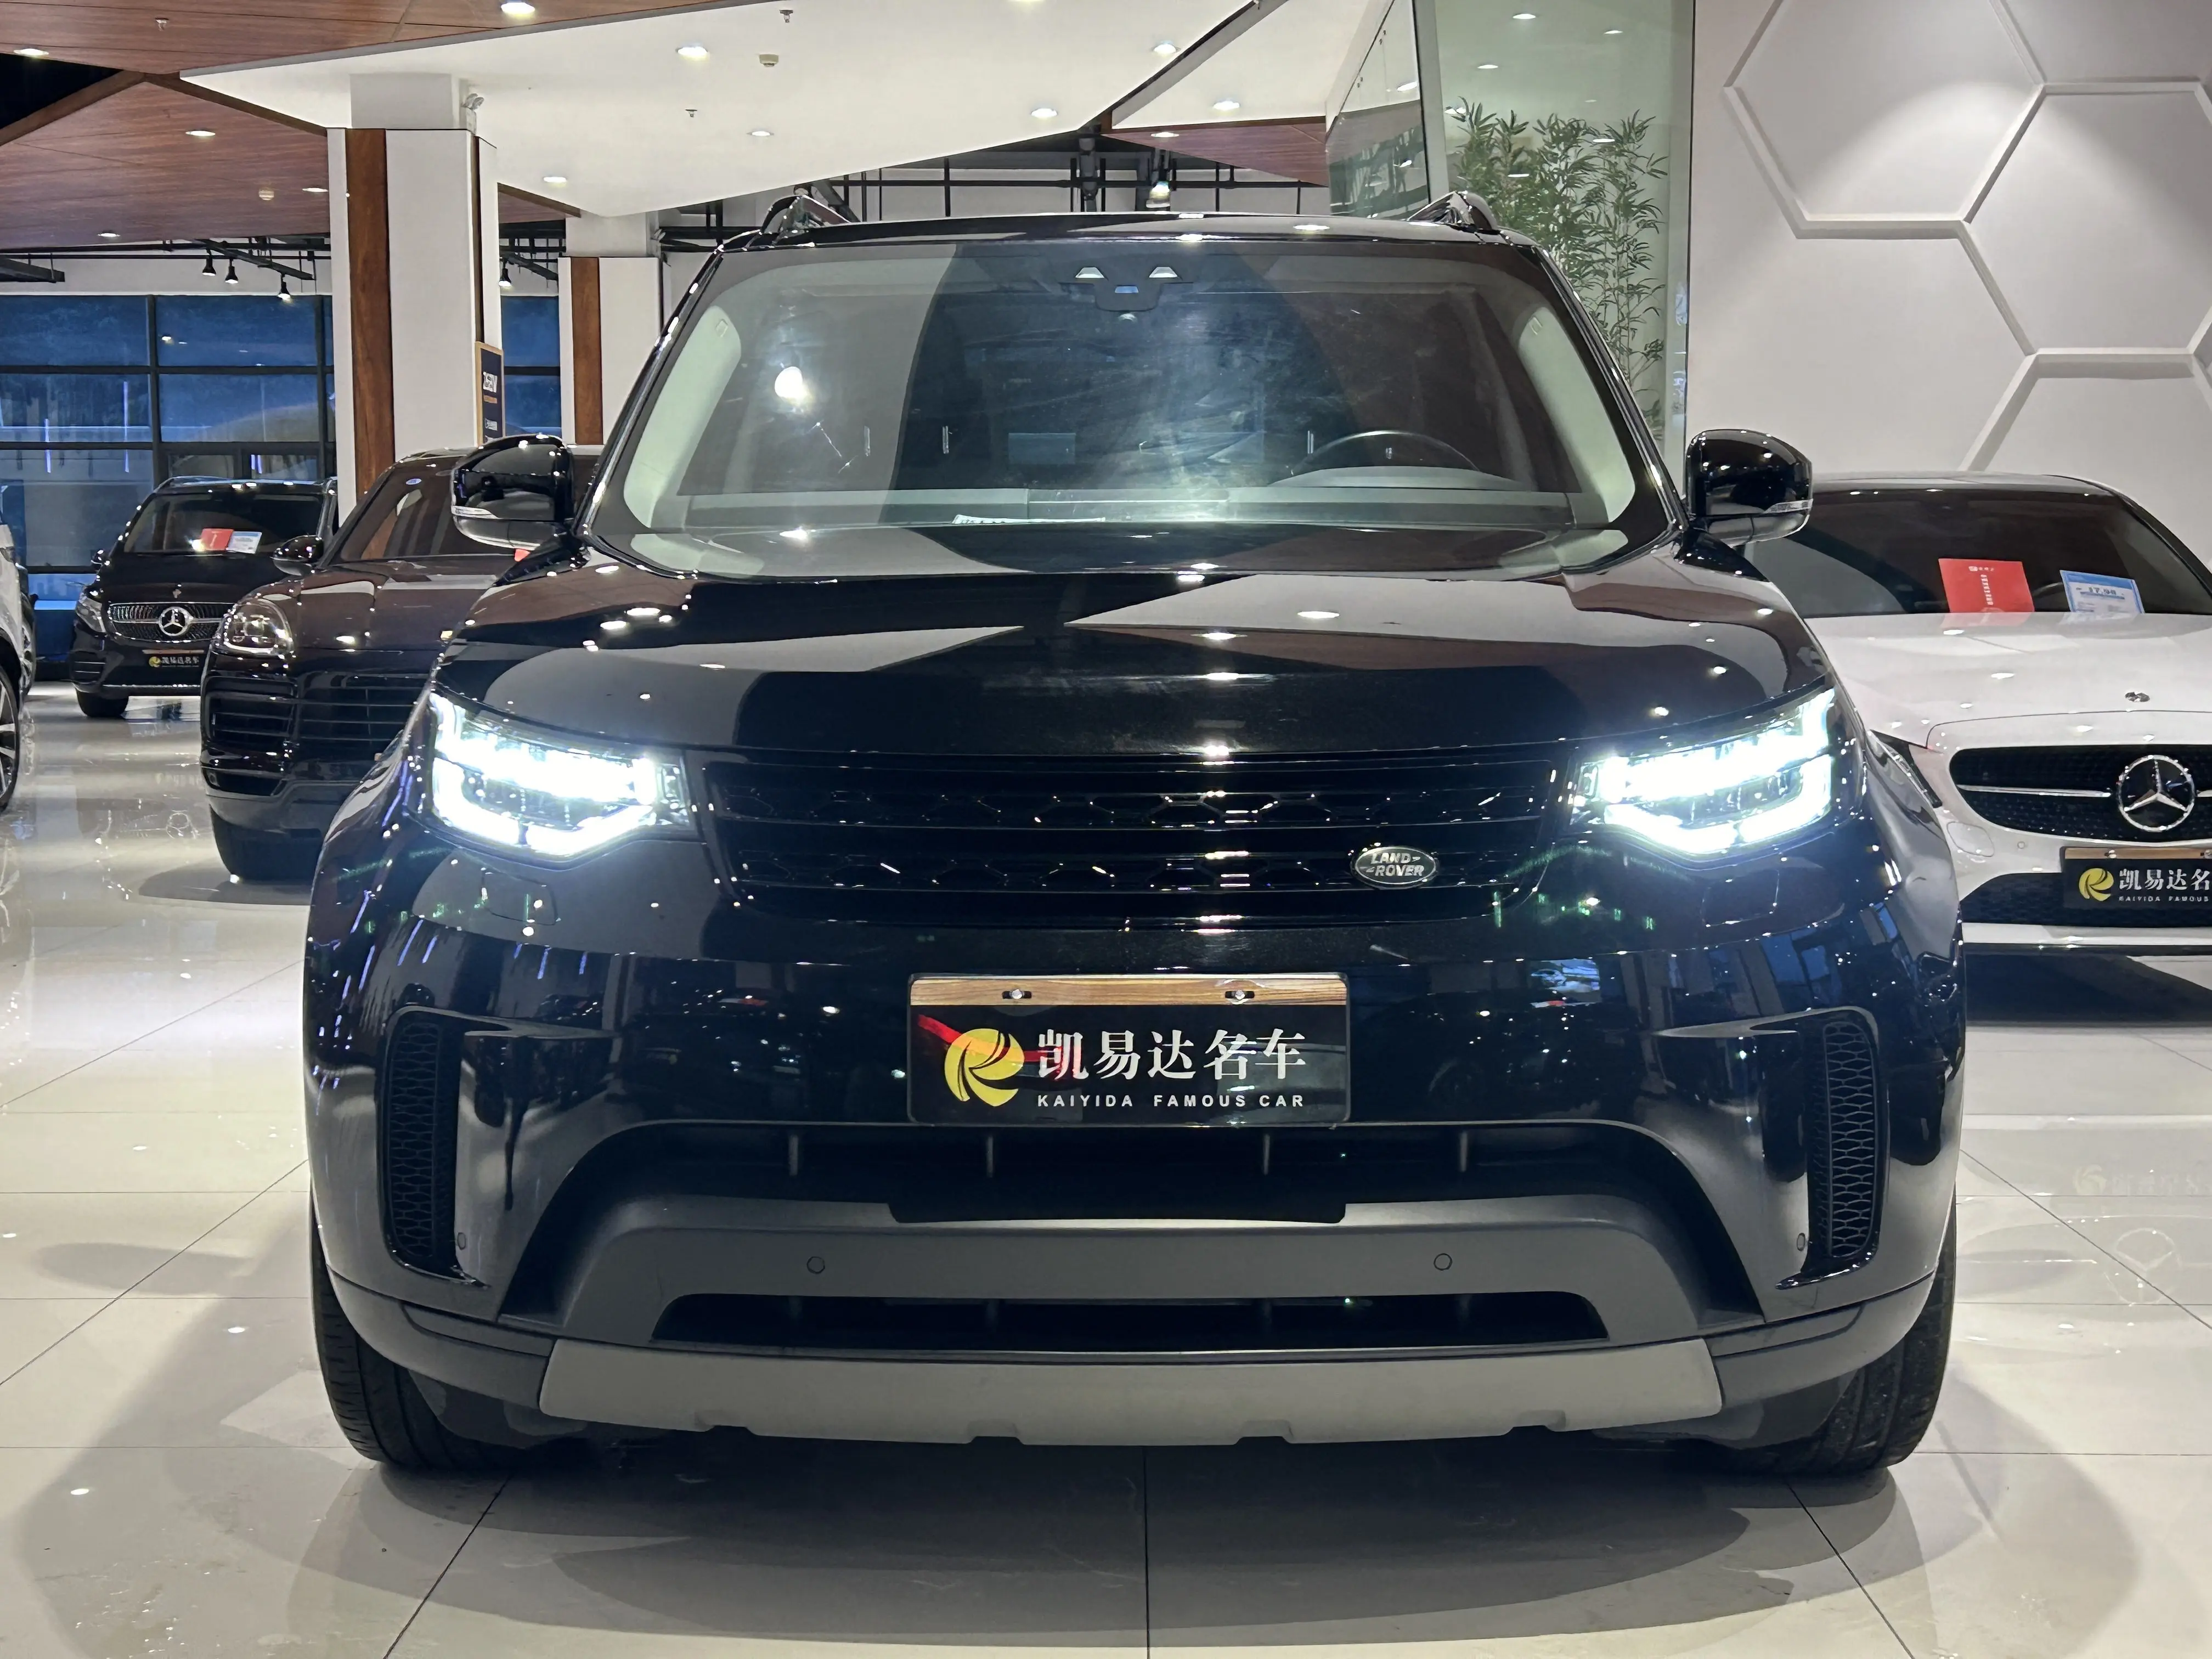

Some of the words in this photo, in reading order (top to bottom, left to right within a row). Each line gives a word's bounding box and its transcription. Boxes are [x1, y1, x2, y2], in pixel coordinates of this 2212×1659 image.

[1370, 852, 1412, 864] LAND
[1374, 865, 1425, 876] ROVER
[1037, 1028, 1306, 1080] 凯易达名车
[1037, 1095, 1133, 1107] KAIYIDA
[1154, 1095, 1246, 1107] FAMOUS
[1259, 1095, 1304, 1107] CAR
